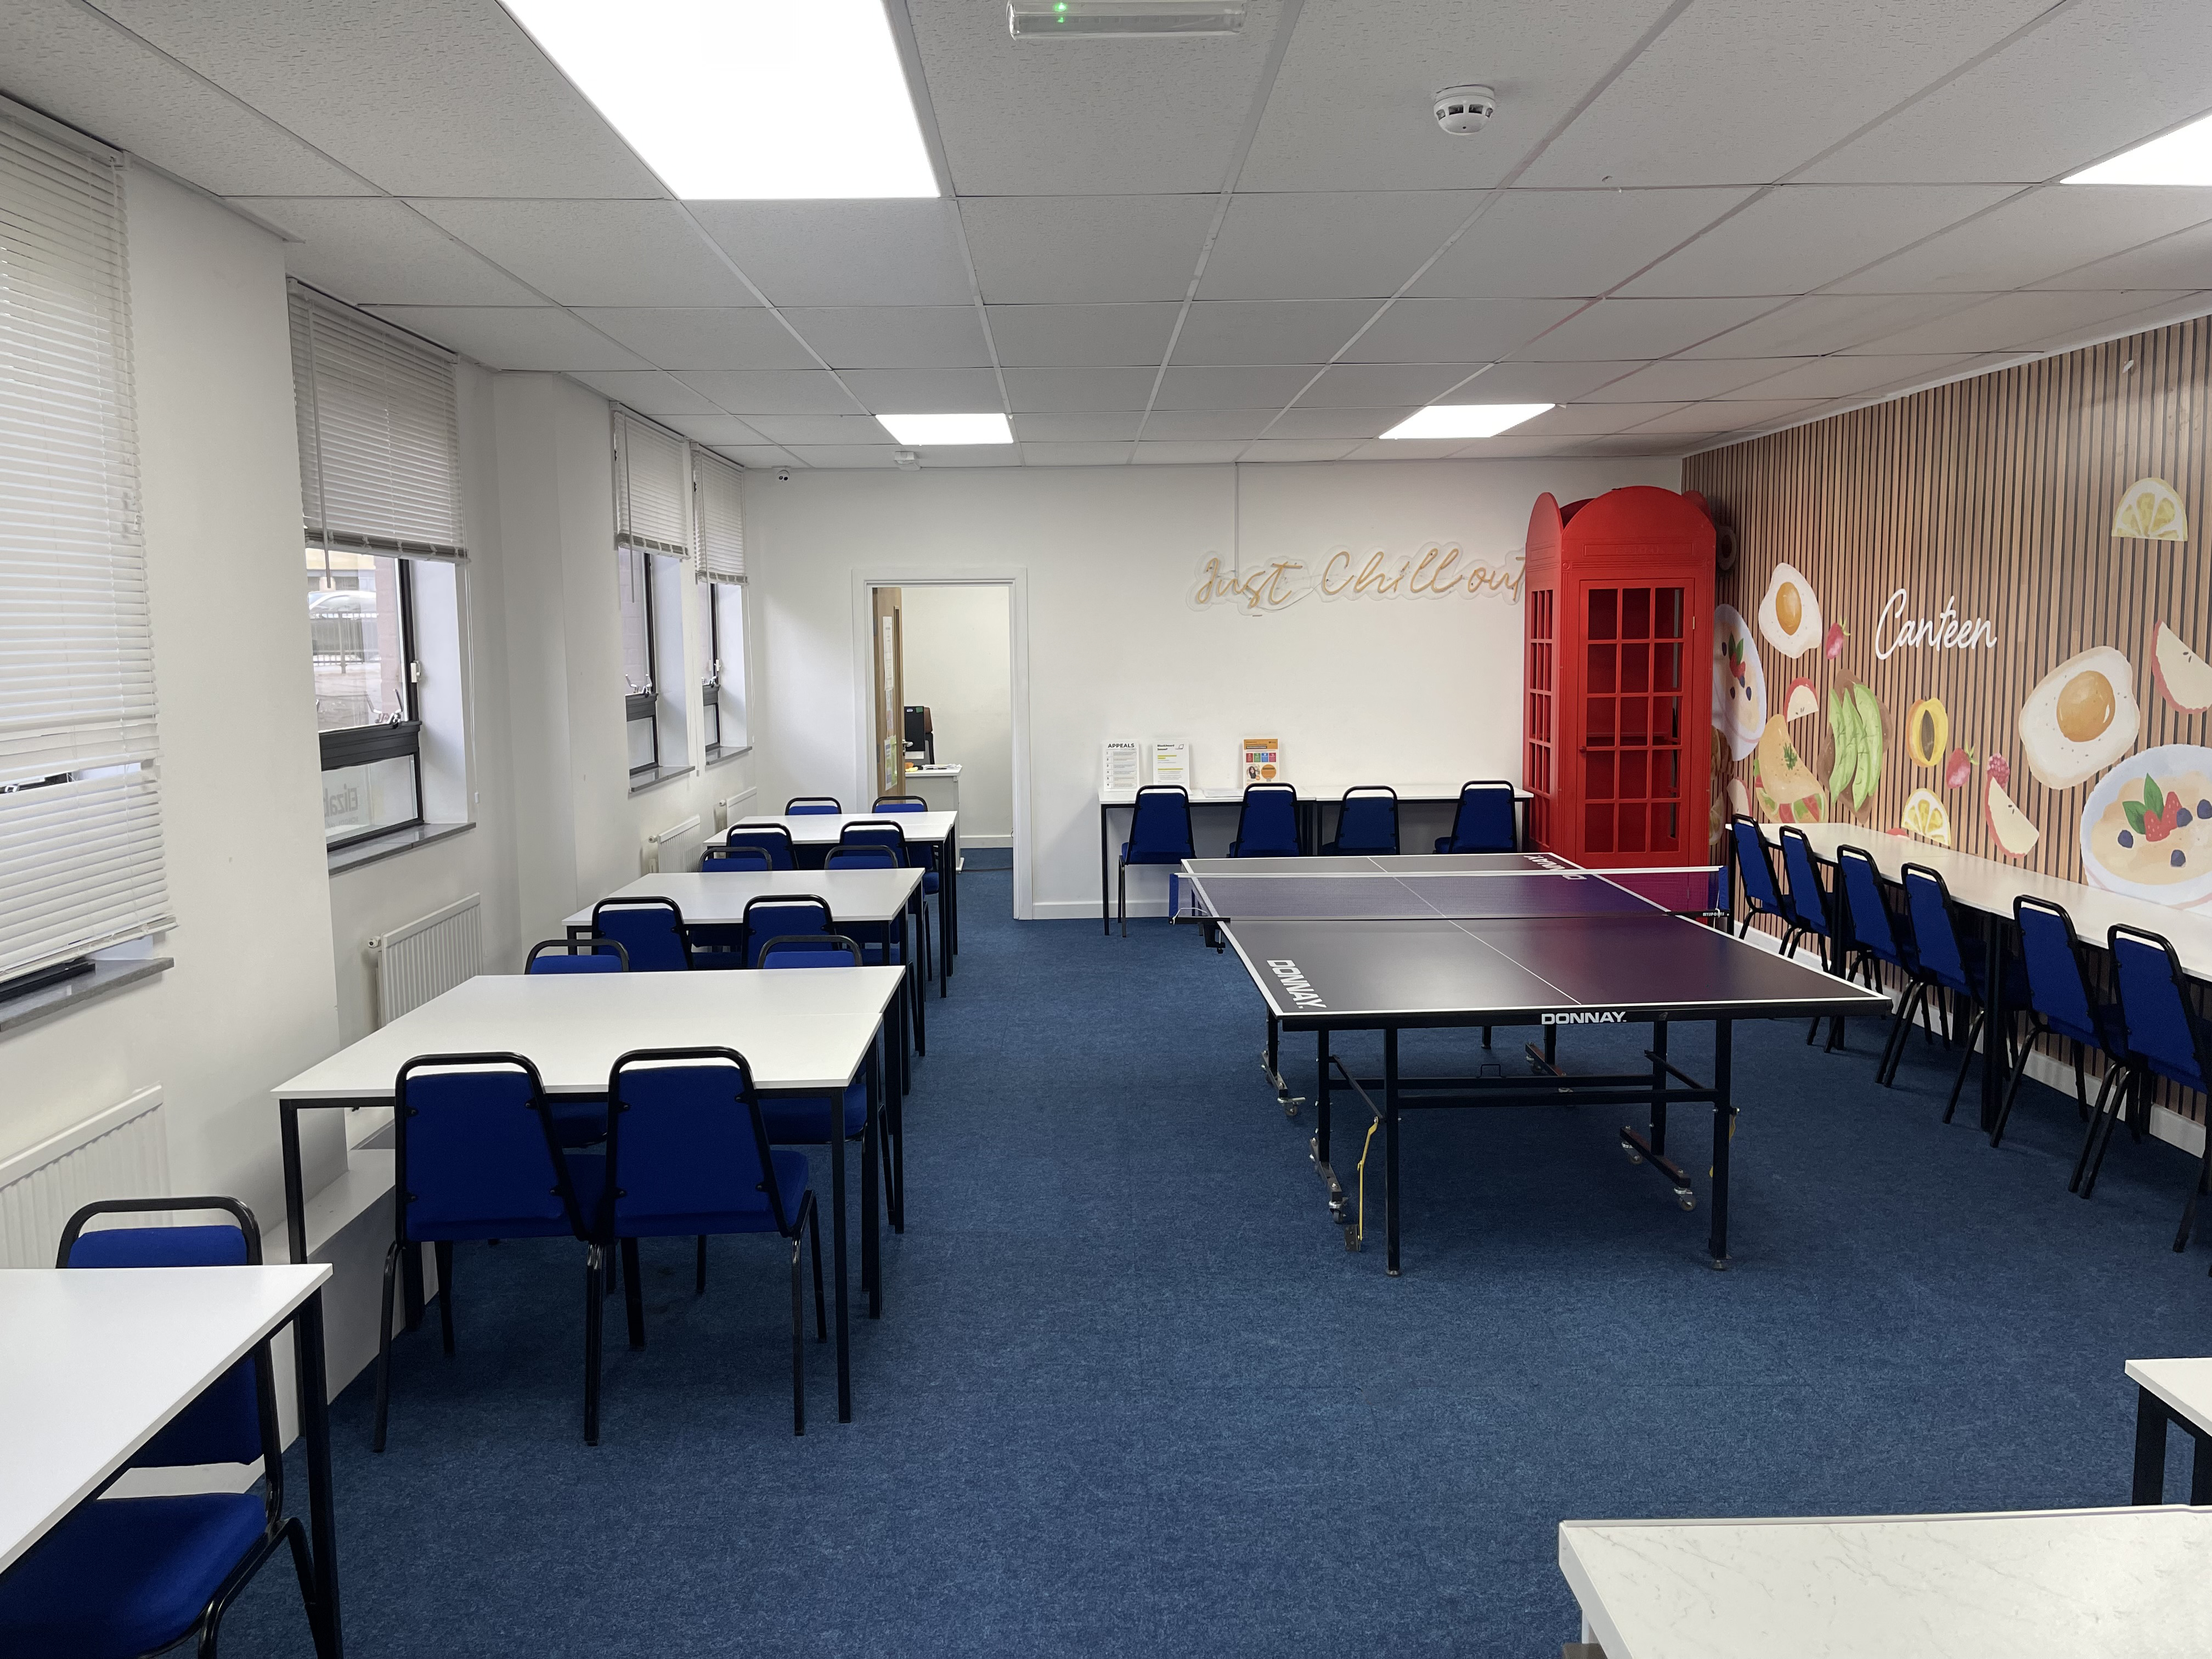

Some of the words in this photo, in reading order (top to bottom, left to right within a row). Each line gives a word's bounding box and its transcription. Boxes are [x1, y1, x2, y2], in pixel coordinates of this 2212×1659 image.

[1197, 557, 1303, 608] Just
[1322, 548, 1463, 594] Chill
[1875, 588, 1997, 660] Canteen
